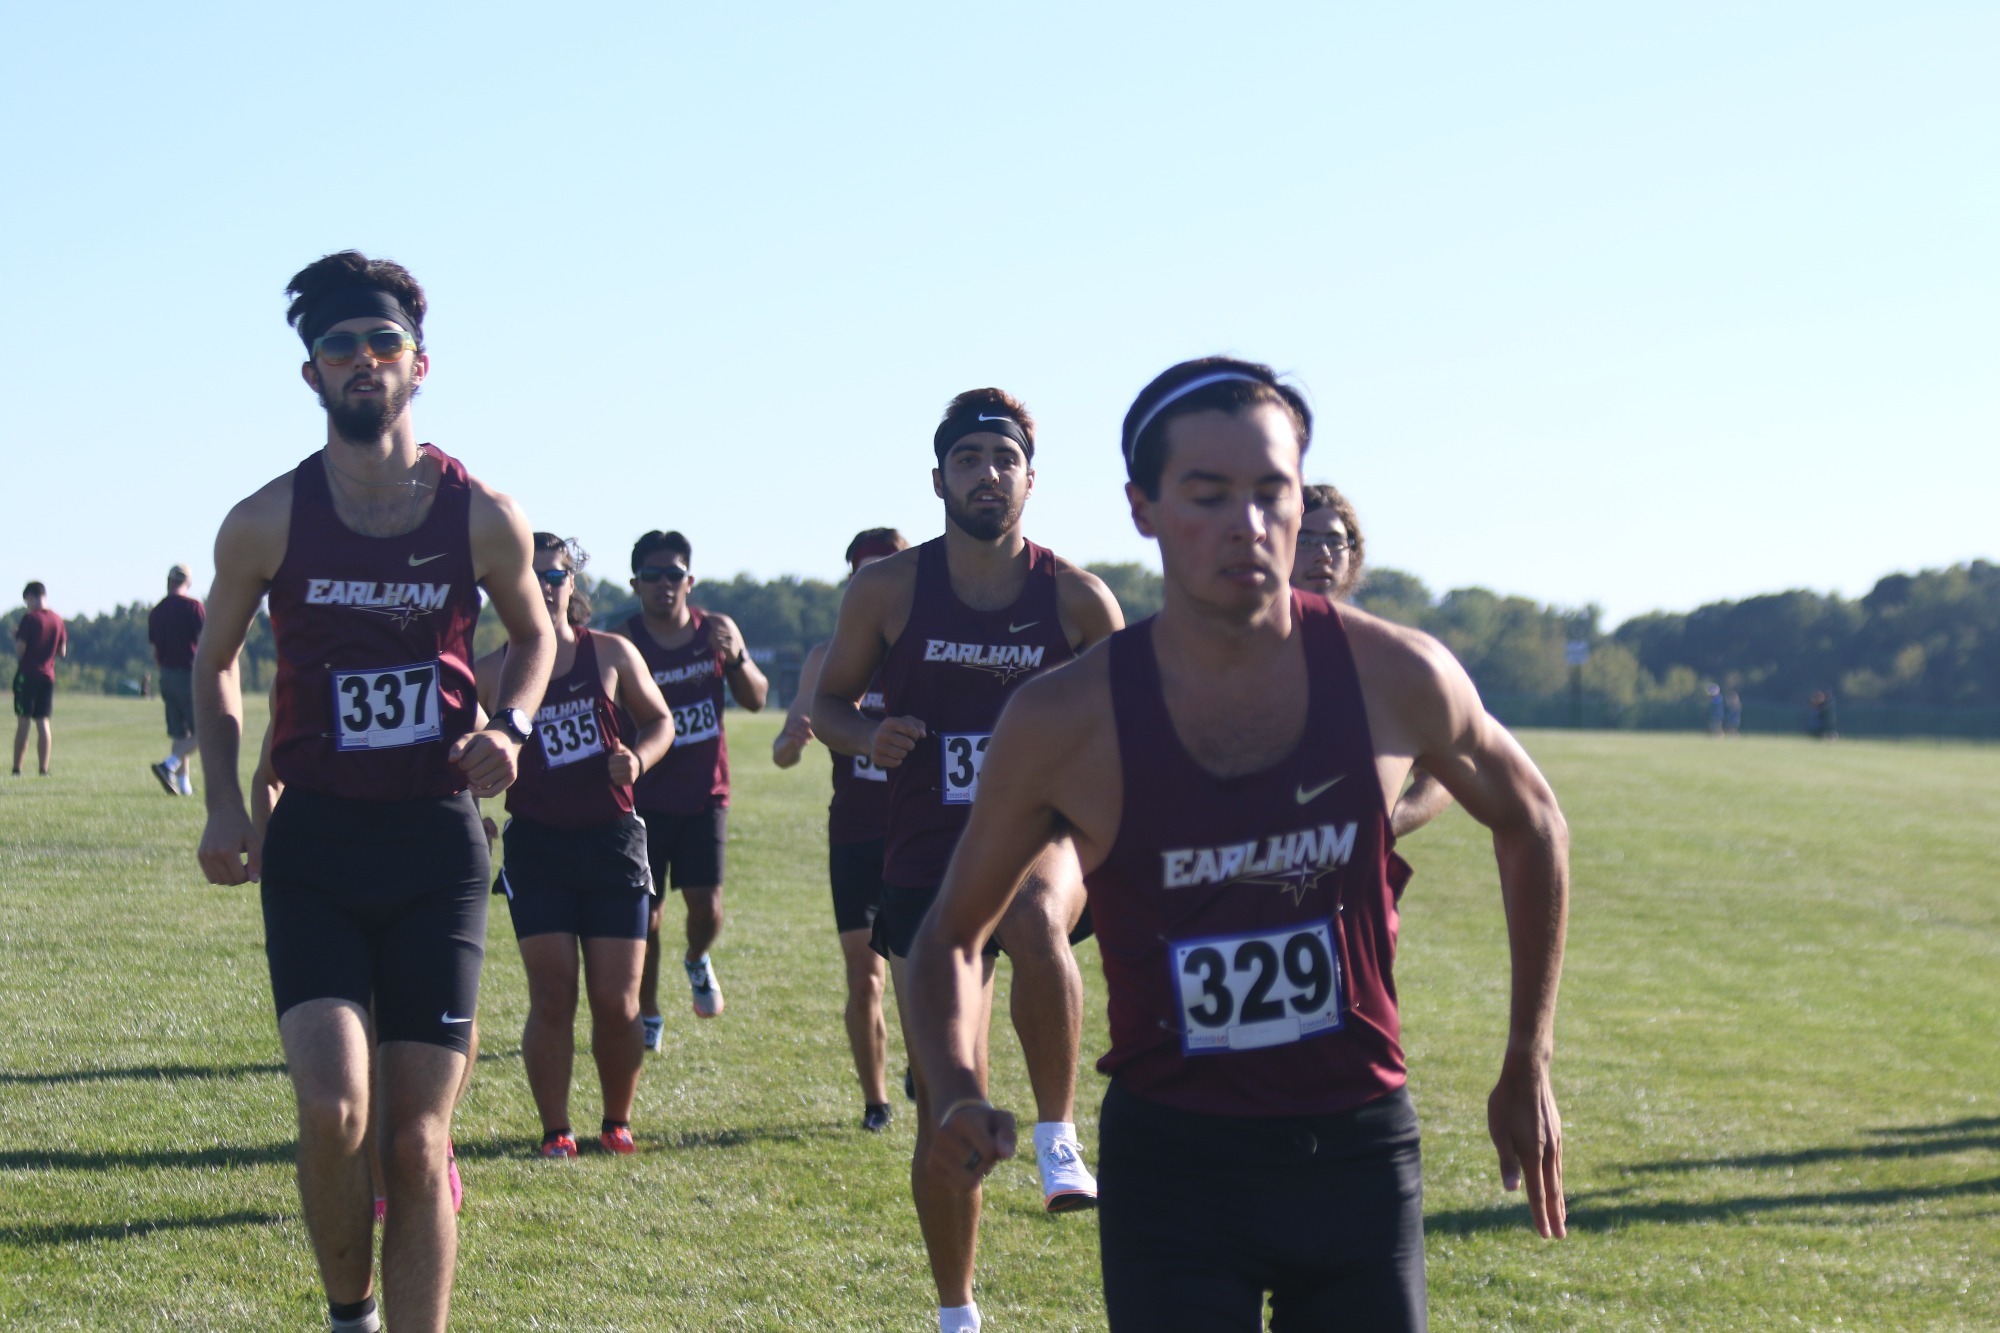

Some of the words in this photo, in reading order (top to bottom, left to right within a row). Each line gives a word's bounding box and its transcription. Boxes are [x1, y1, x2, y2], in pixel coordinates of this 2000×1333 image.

[306, 579, 450, 609] EARLHAM
[923, 639, 1045, 668] EARLHAM
[653, 660, 715, 685] EARLHAM
[341, 668, 434, 732] 337
[533, 697, 595, 722] ARLHAM
[543, 713, 597, 757] 335
[673, 703, 715, 737] 328
[1161, 822, 1358, 889] EARLHAM
[1183, 932, 1332, 1028] 329
